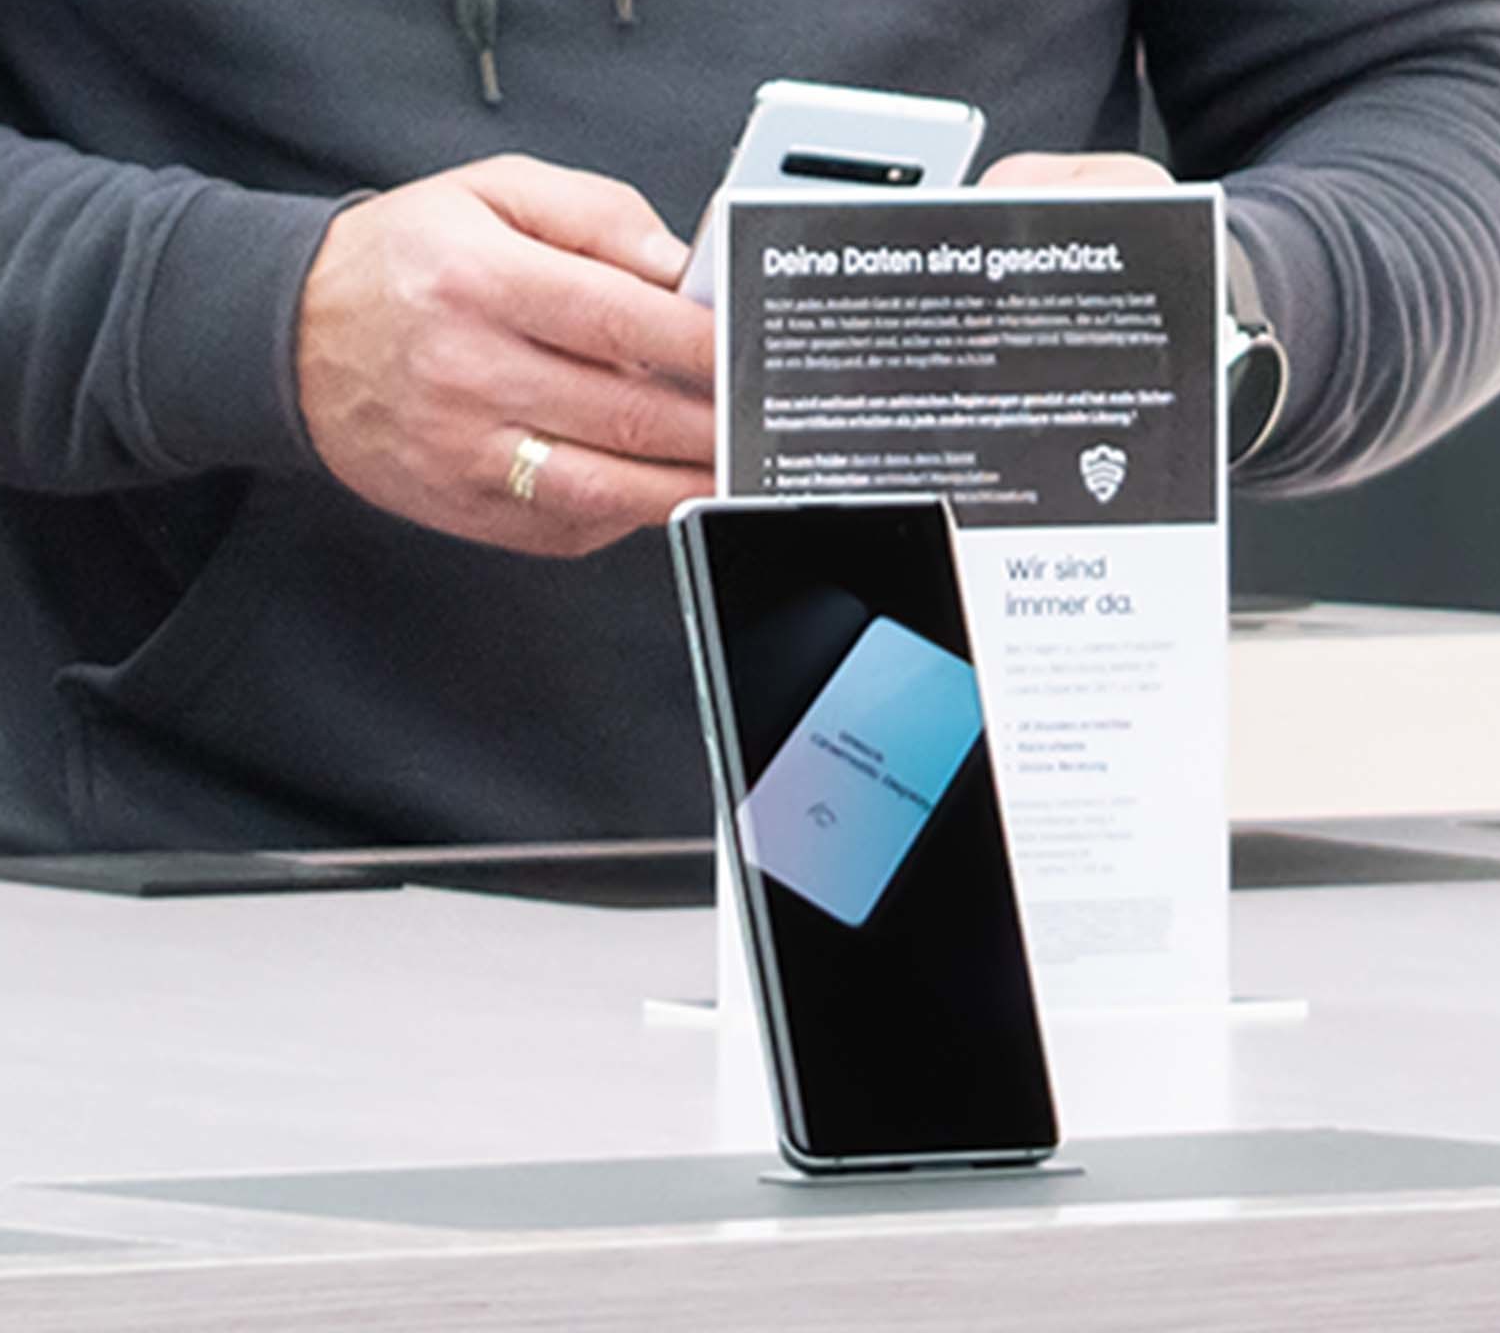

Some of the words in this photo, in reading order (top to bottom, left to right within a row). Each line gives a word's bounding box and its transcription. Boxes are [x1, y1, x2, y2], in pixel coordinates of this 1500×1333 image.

[763, 246, 839, 276] Deine
[843, 244, 922, 274] Daten
[928, 242, 982, 273] sind
[986, 242, 1124, 281] geschützt.
[1005, 555, 1047, 581] Wir
[1054, 553, 1107, 581] sind
[1005, 590, 1090, 616] immer
